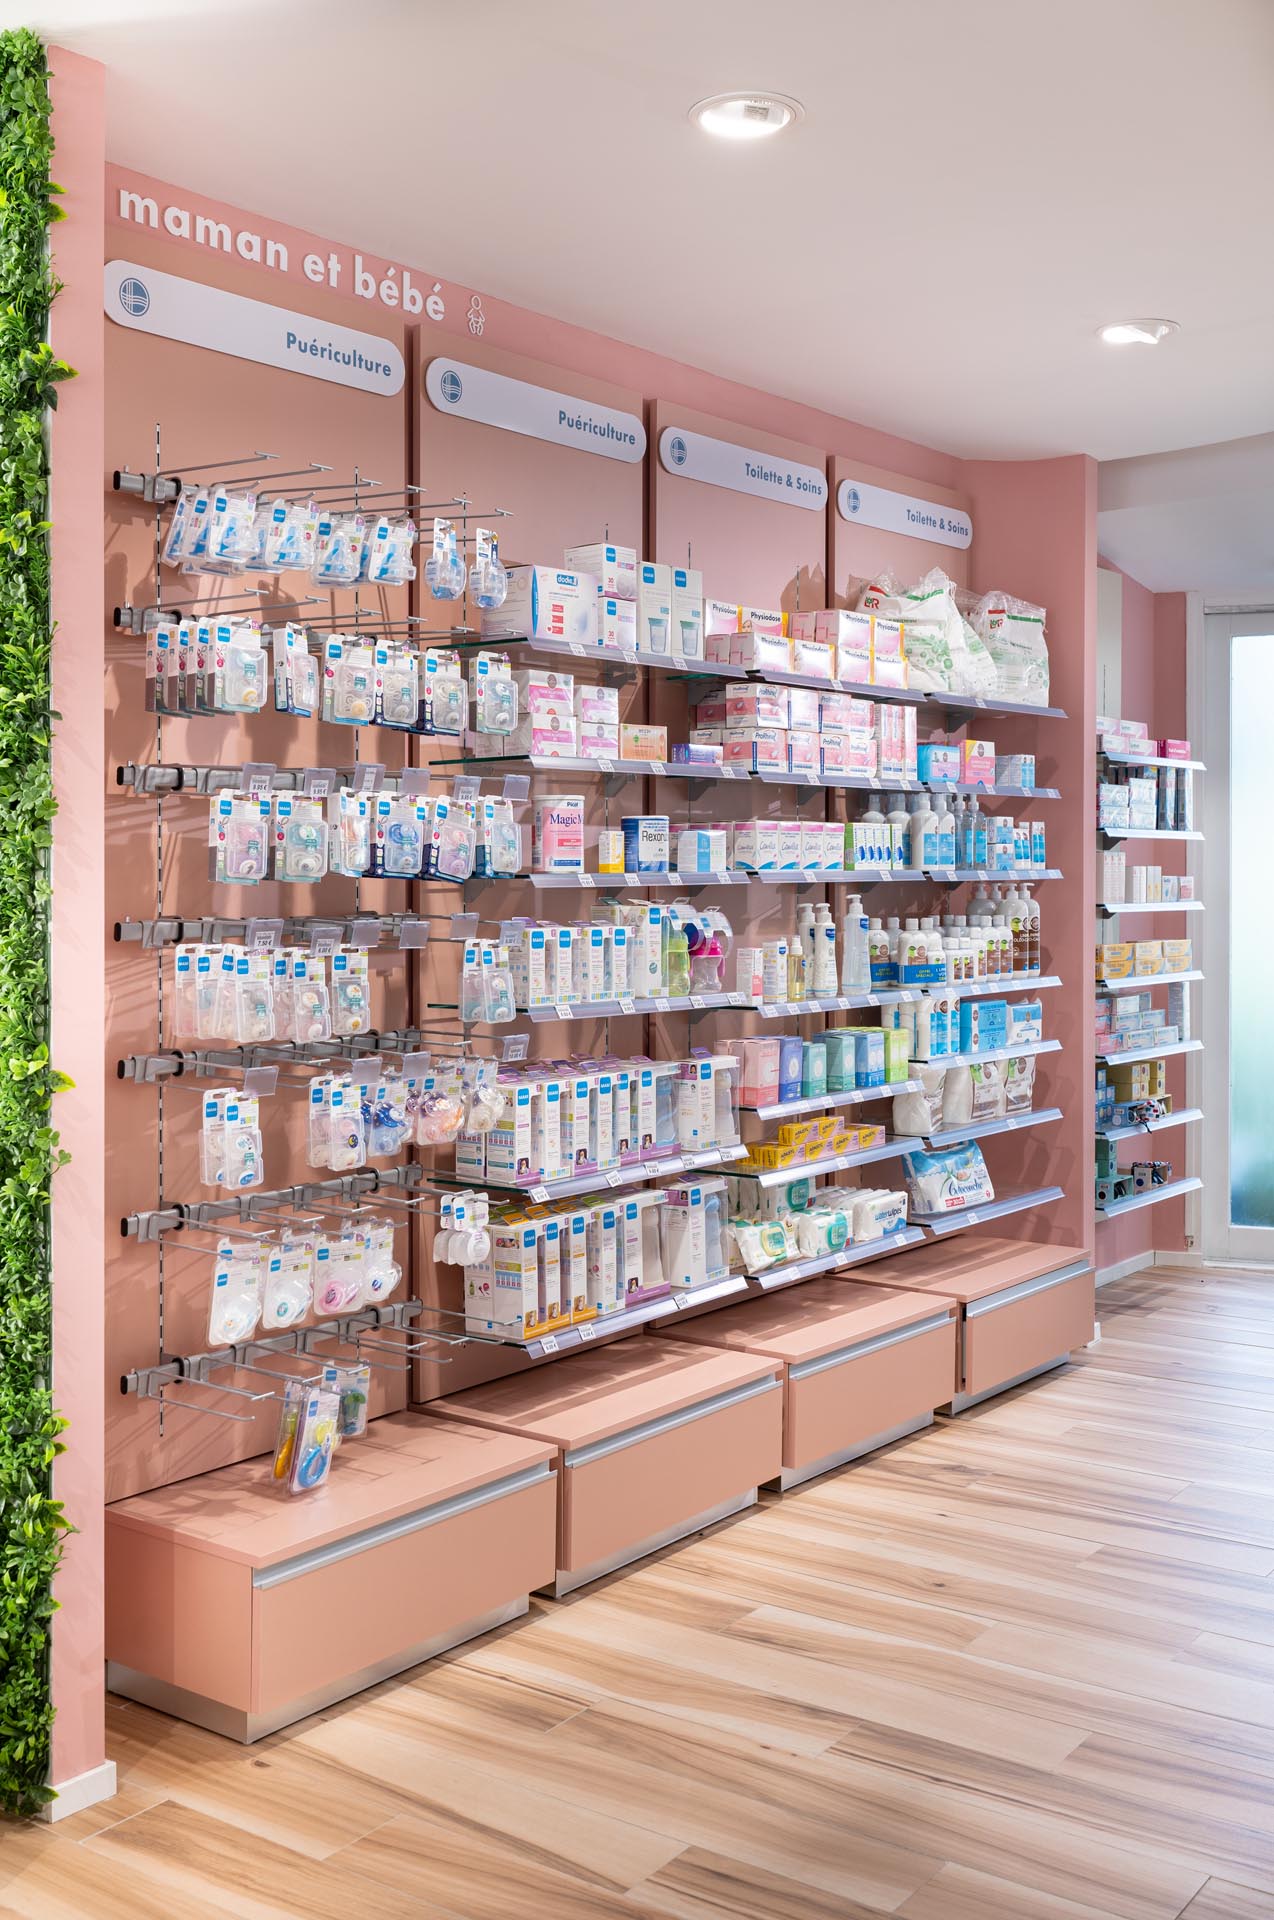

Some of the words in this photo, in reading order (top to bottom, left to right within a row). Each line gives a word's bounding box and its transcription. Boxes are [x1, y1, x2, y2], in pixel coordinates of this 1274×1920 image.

[119, 188, 289, 272] maman
[303, 253, 341, 288] et
[354, 254, 445, 321] bébé
[286, 331, 392, 377] Puériculture
[559, 410, 636, 446] Puériculture
[745, 463, 784, 485] Toilette
[785, 475, 794, 488] &
[796, 479, 822, 495] Soins
[906, 509, 937, 528] Toilette
[939, 518, 946, 530] &
[947, 521, 969, 537] Soins
[712, 603, 738, 616] Physiodose
[750, 611, 781, 624] Physiodose
[550, 813, 577, 827] Magic
